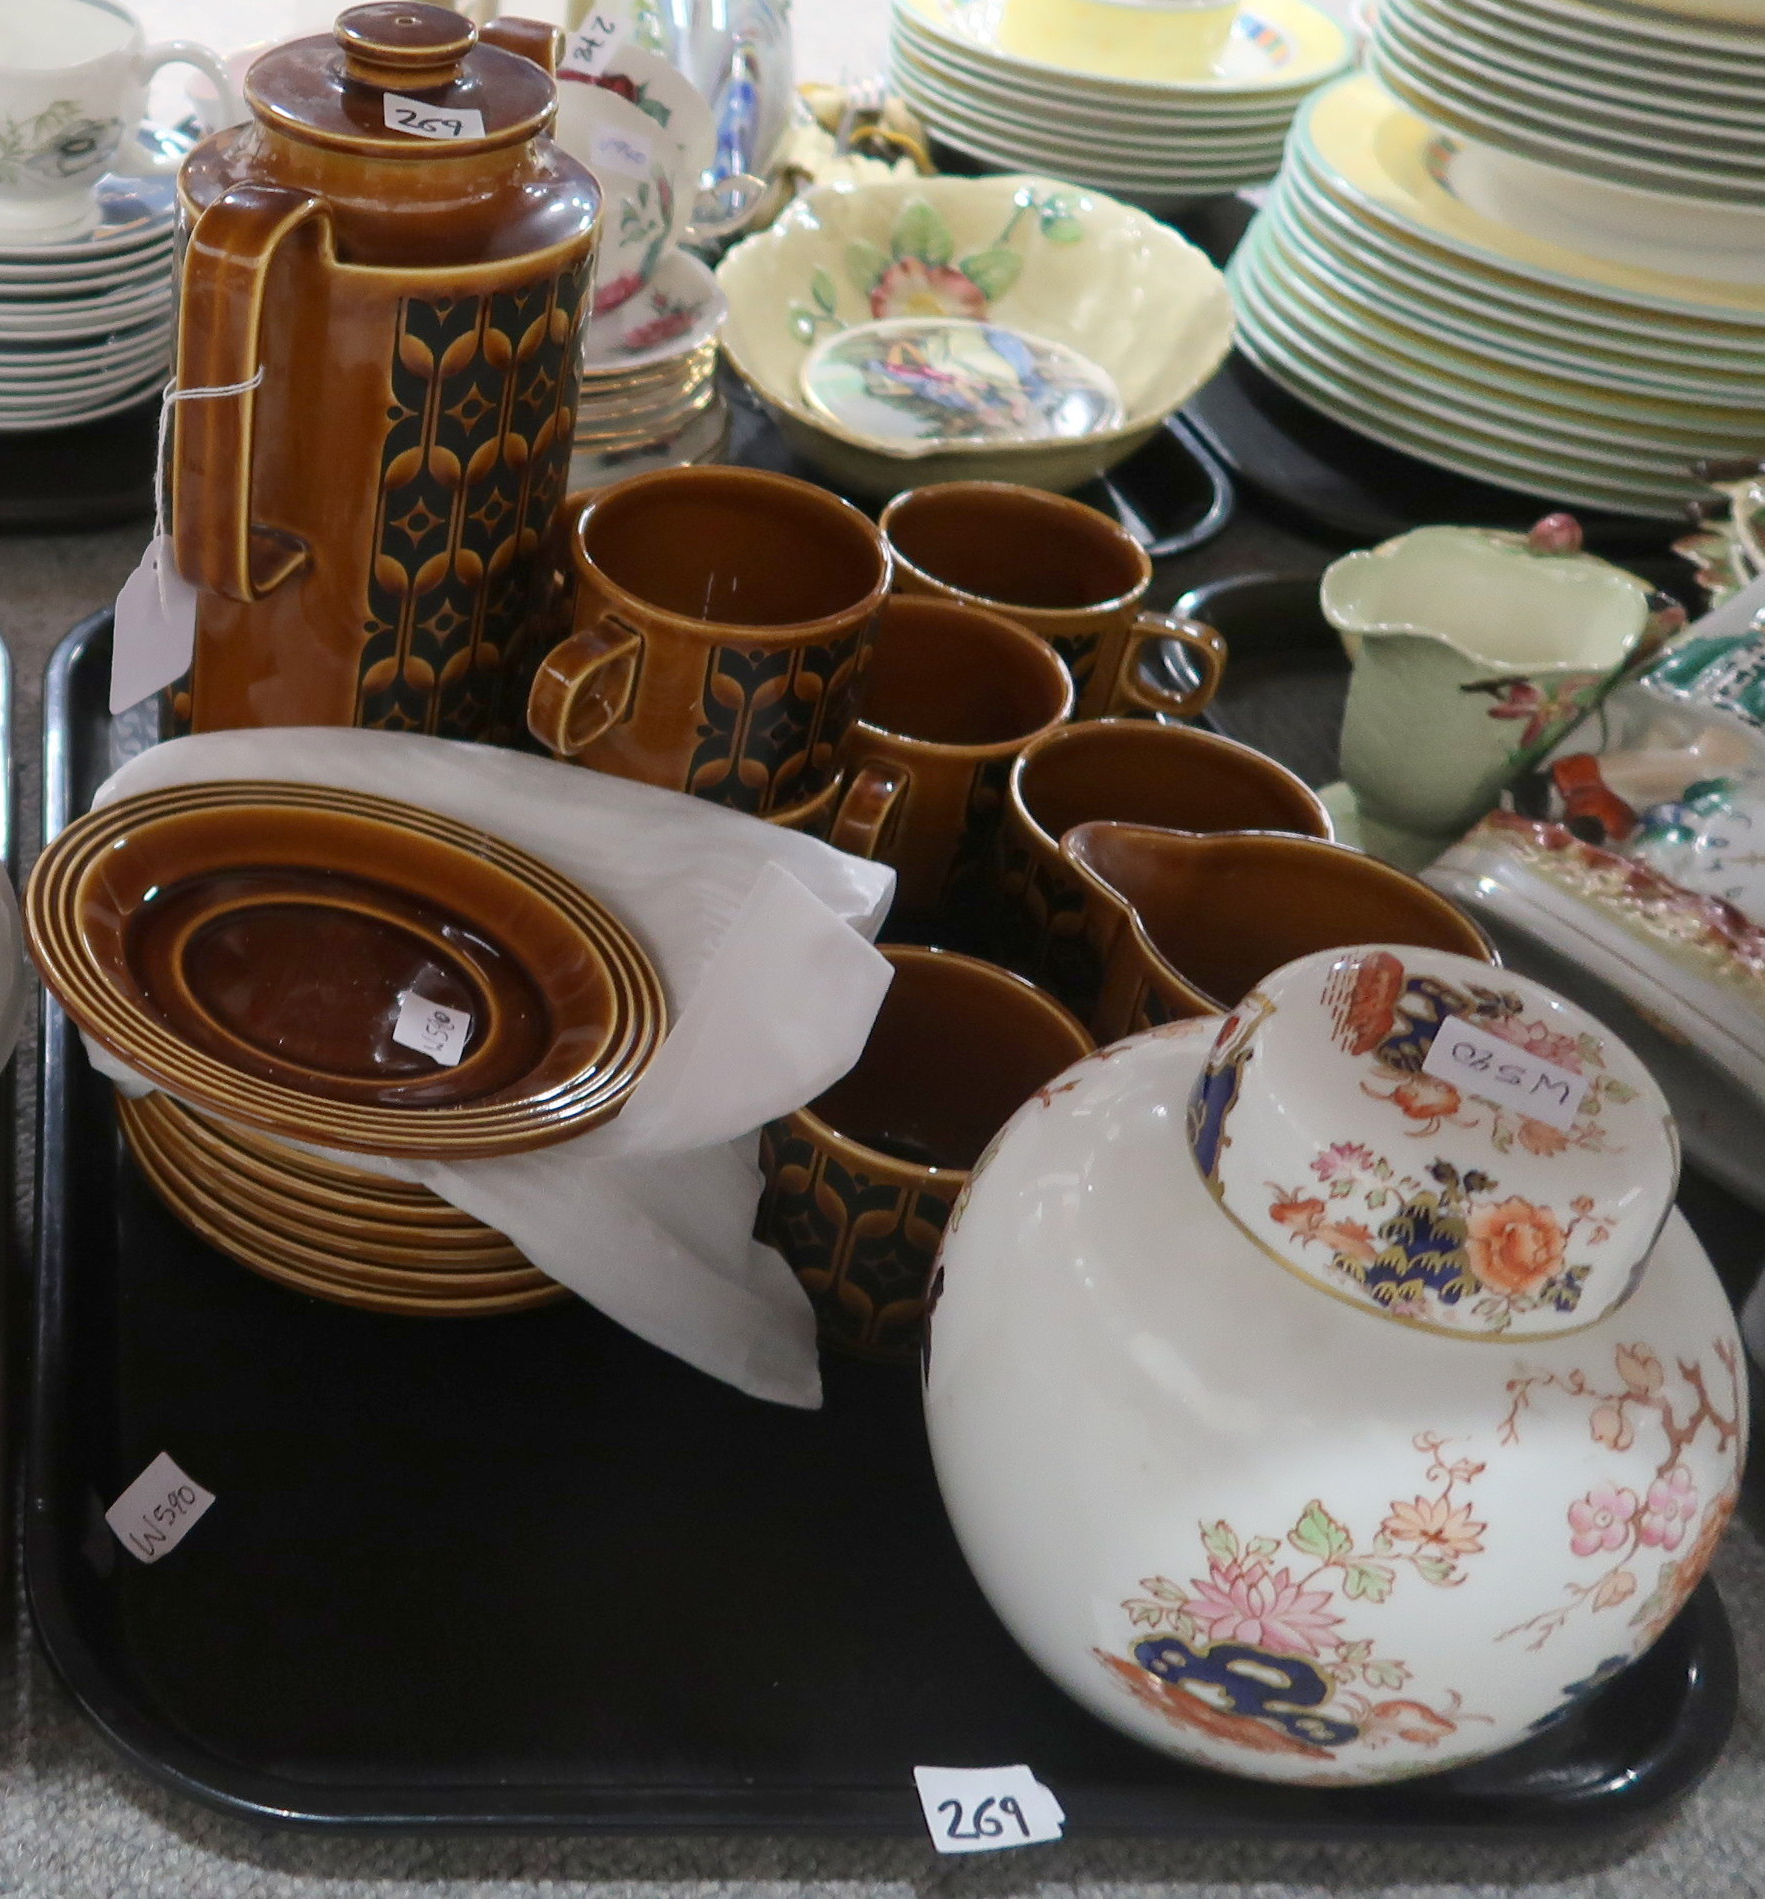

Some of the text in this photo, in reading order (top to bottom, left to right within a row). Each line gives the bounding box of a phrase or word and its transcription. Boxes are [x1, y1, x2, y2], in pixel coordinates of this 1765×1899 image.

[395, 108, 462, 136] 269
[129, 1485, 195, 1556] W590
[938, 1795, 1030, 1839] 269
